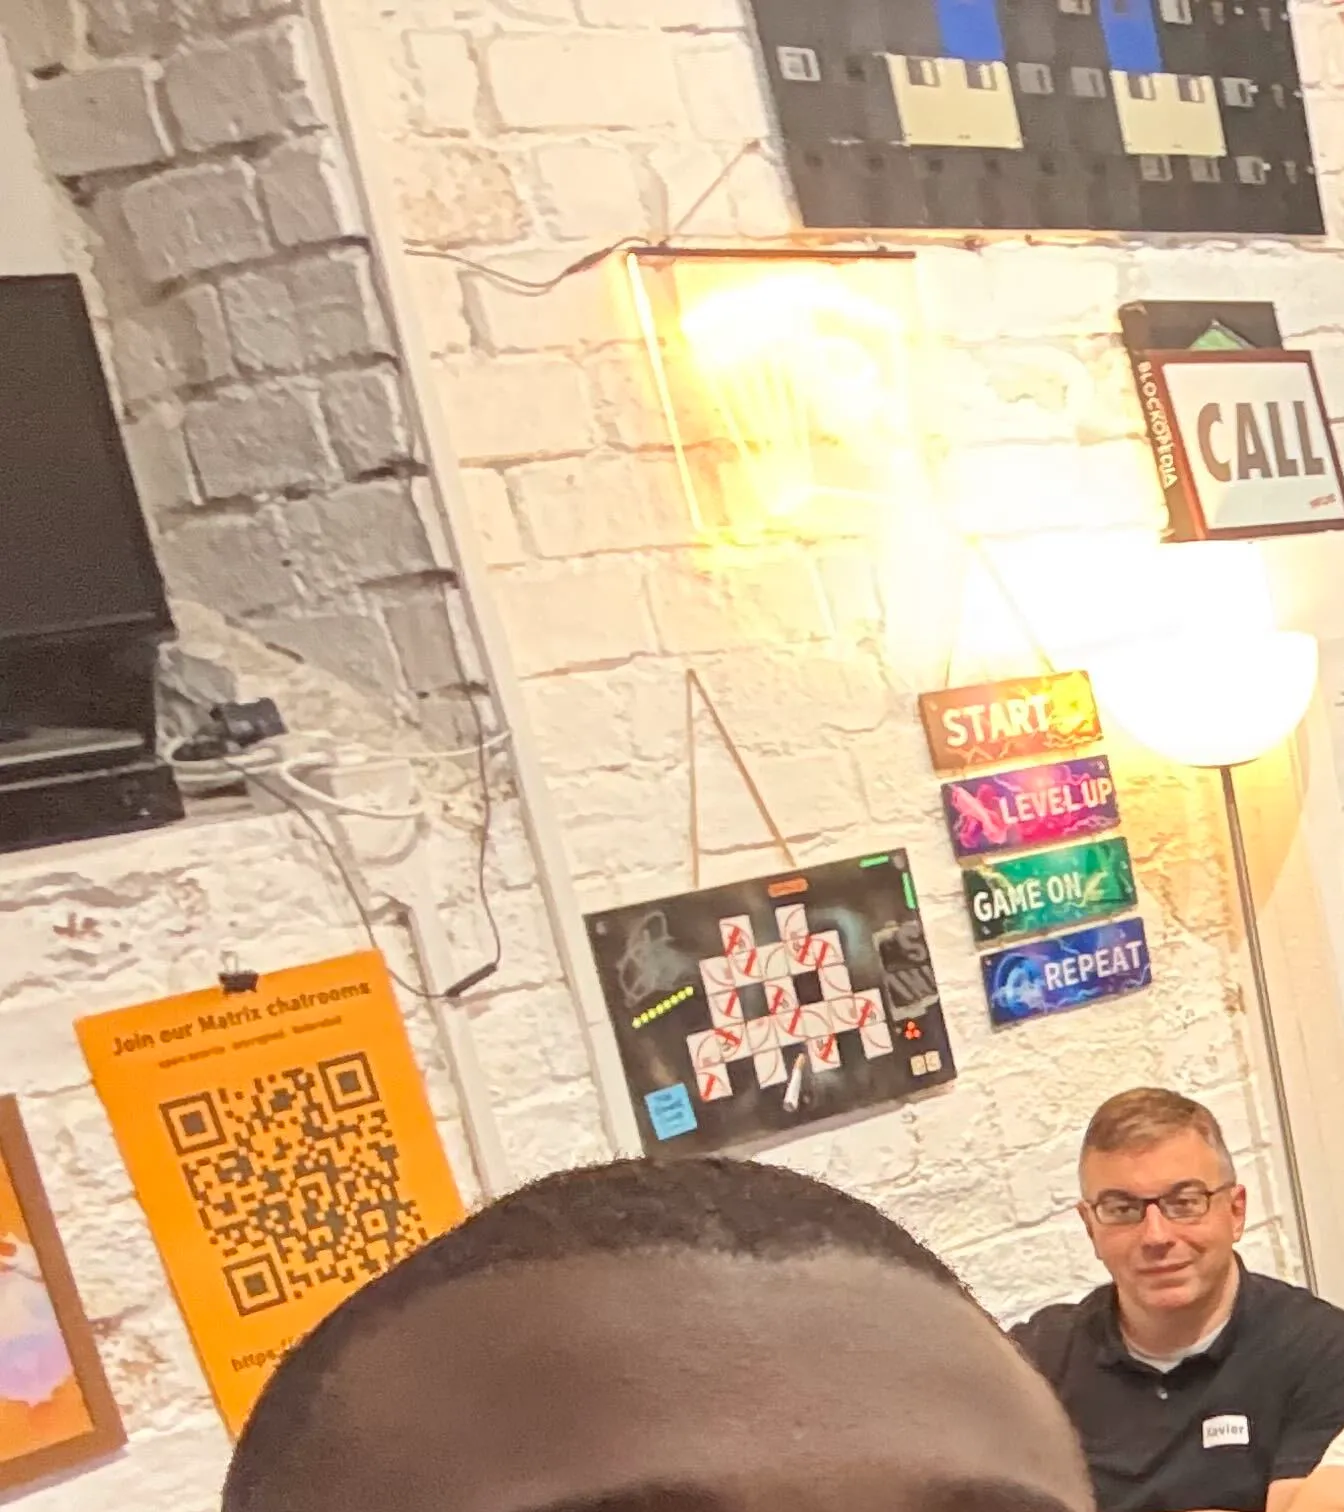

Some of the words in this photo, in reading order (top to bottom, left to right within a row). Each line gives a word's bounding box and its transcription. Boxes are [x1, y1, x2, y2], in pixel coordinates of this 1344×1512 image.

[1197, 400, 1326, 482] CALL
[942, 692, 1051, 747] START
[1000, 787, 1079, 825] LEVEL
[1084, 777, 1113, 810] UP
[973, 884, 1041, 923] GAME
[1047, 871, 1082, 903] ON
[1044, 942, 1143, 991] REPEAT
[112, 1032, 154, 1056] Join
[159, 1023, 193, 1044] our
[198, 1005, 262, 1033] Matrix
[266, 982, 371, 1017] chatrooms
